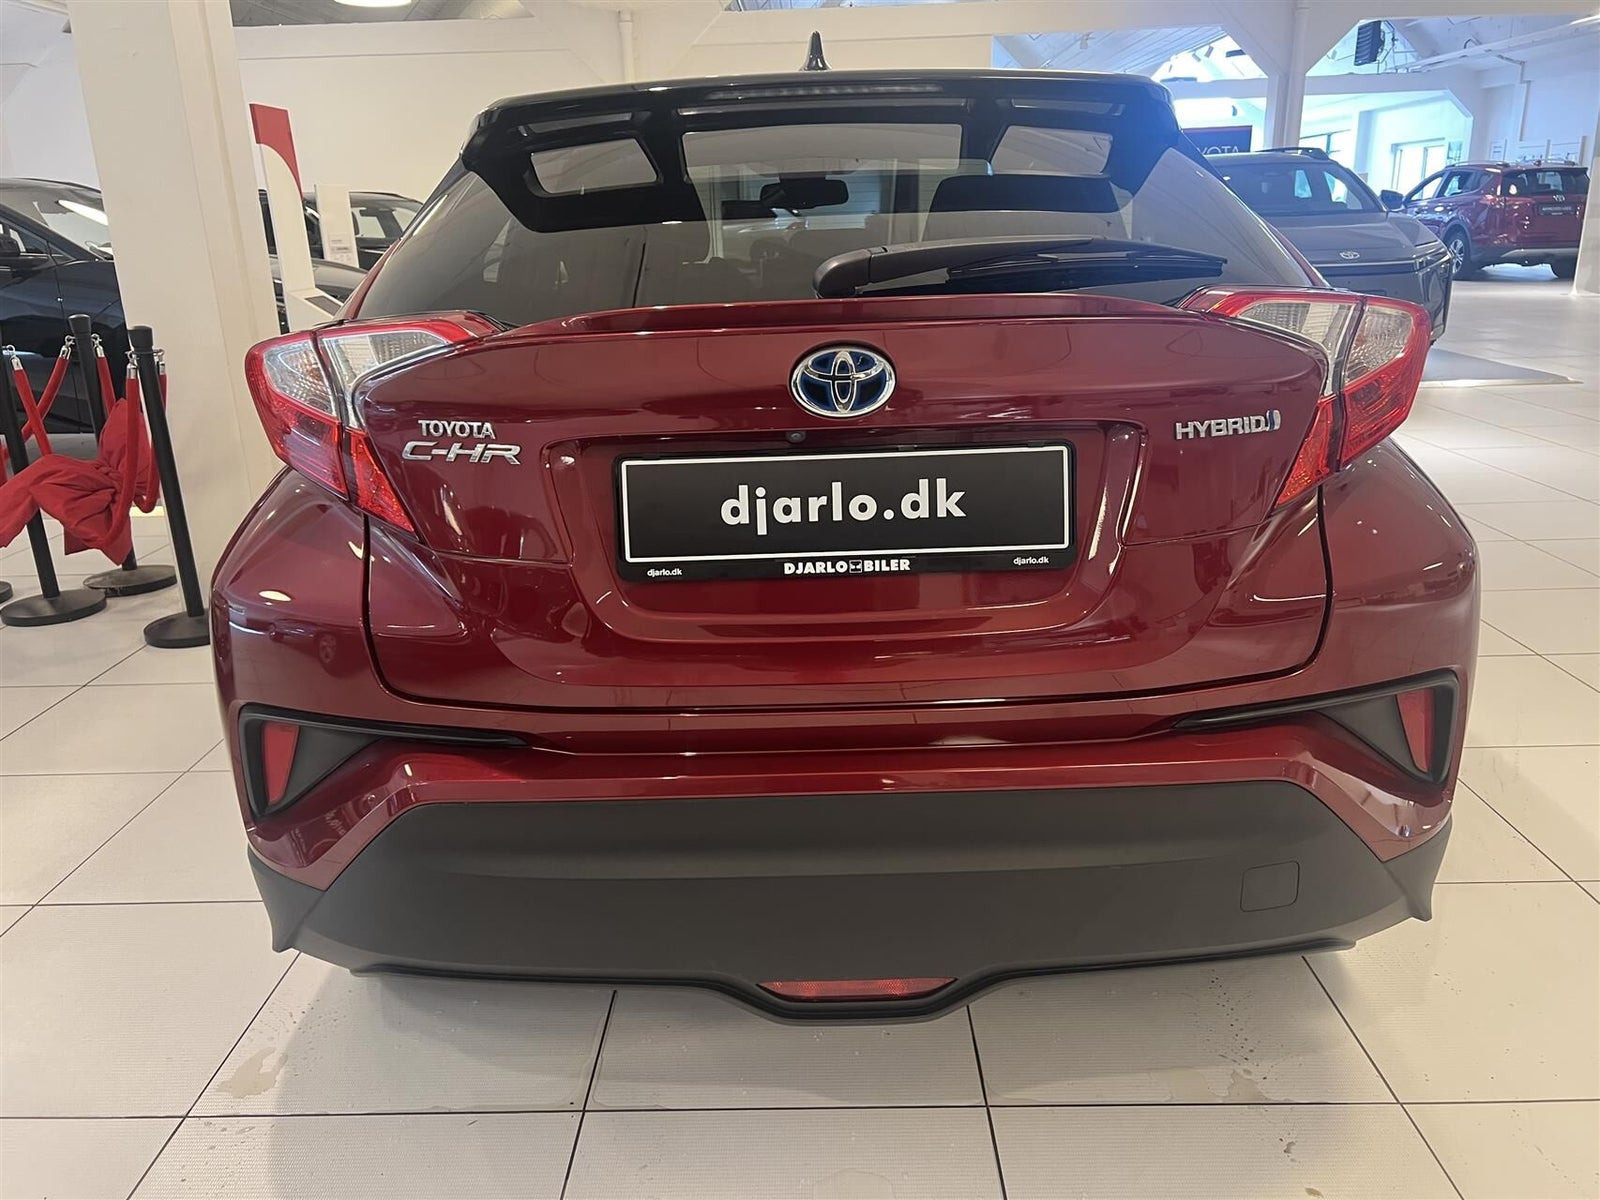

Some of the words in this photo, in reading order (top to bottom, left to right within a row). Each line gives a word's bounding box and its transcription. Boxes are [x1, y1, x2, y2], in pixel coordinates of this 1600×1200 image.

[1197, 145, 1240, 155] YOTA
[418, 419, 496, 439] TOYOTA
[1175, 415, 1266, 440] HYBRID
[402, 441, 521, 465] C-HR
[720, 477, 967, 536] djarlo.dk
[783, 560, 848, 575] DJARLO
[863, 559, 911, 572] BILER
[1013, 556, 1050, 566] djarlo.dk
[647, 568, 683, 577] djarlo.dk
